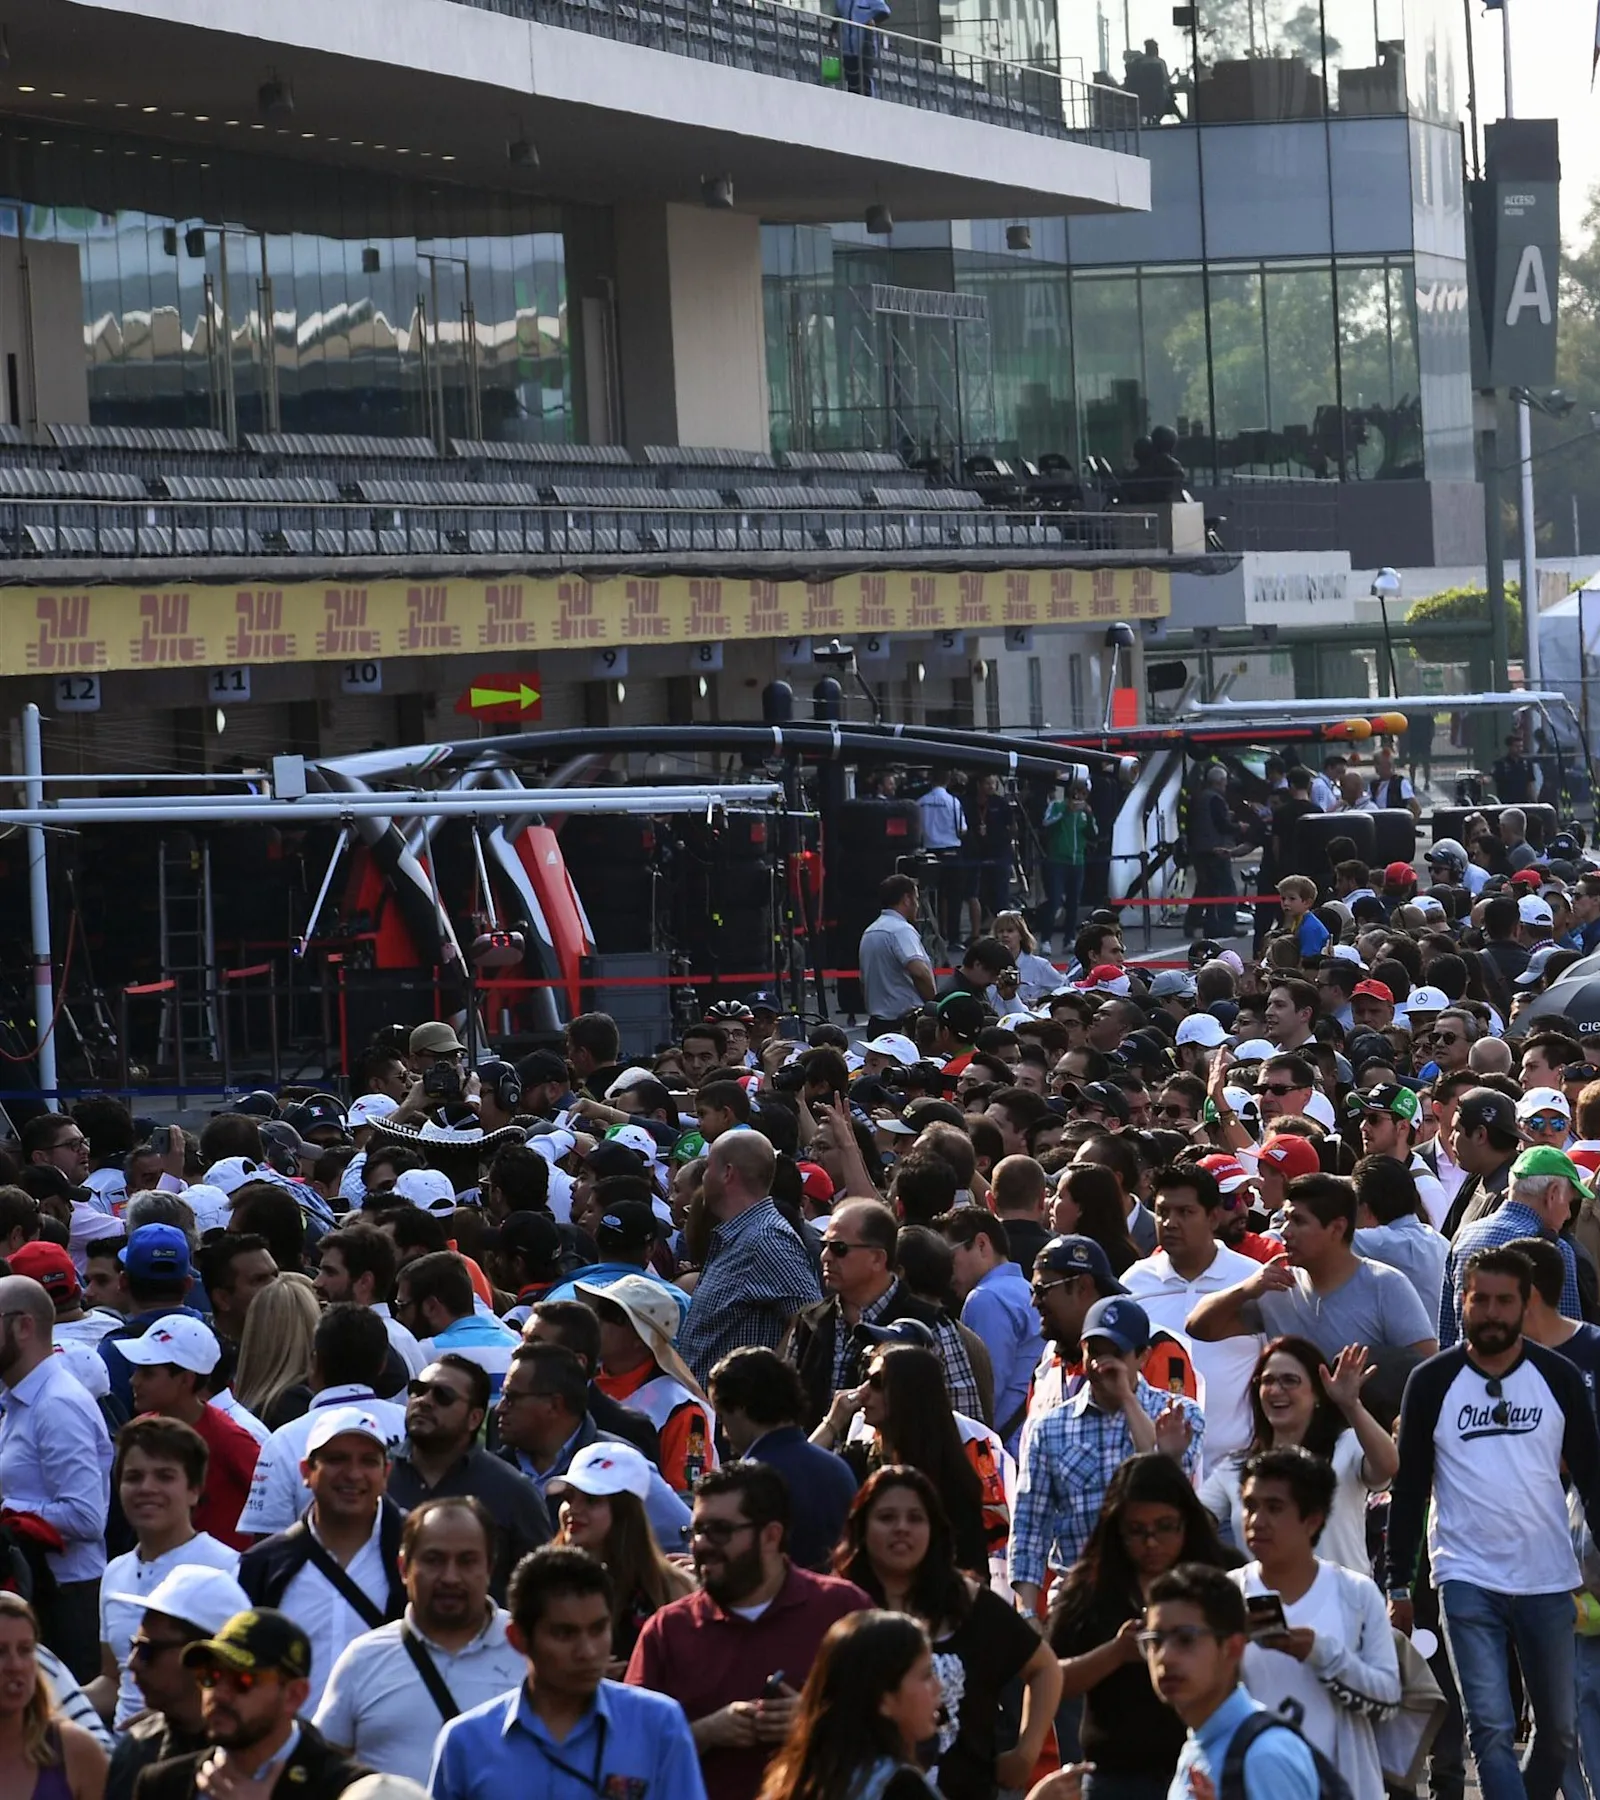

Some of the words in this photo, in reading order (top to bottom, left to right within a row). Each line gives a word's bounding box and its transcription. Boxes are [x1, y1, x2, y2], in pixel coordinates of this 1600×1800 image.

[1504, 195, 1536, 206] ACCESO
[1505, 244, 1552, 327] A
[867, 634, 880, 651] 6
[943, 632, 954, 648] 5
[1013, 629, 1025, 645] 4
[700, 644, 712, 661] 8
[788, 639, 801, 657] 7
[602, 650, 617, 669] 9
[213, 670, 246, 691] 11
[346, 663, 377, 683] 10
[60, 678, 96, 700] 12
[1578, 1021, 1600, 1033] cie
[1458, 1404, 1491, 1431] Old
